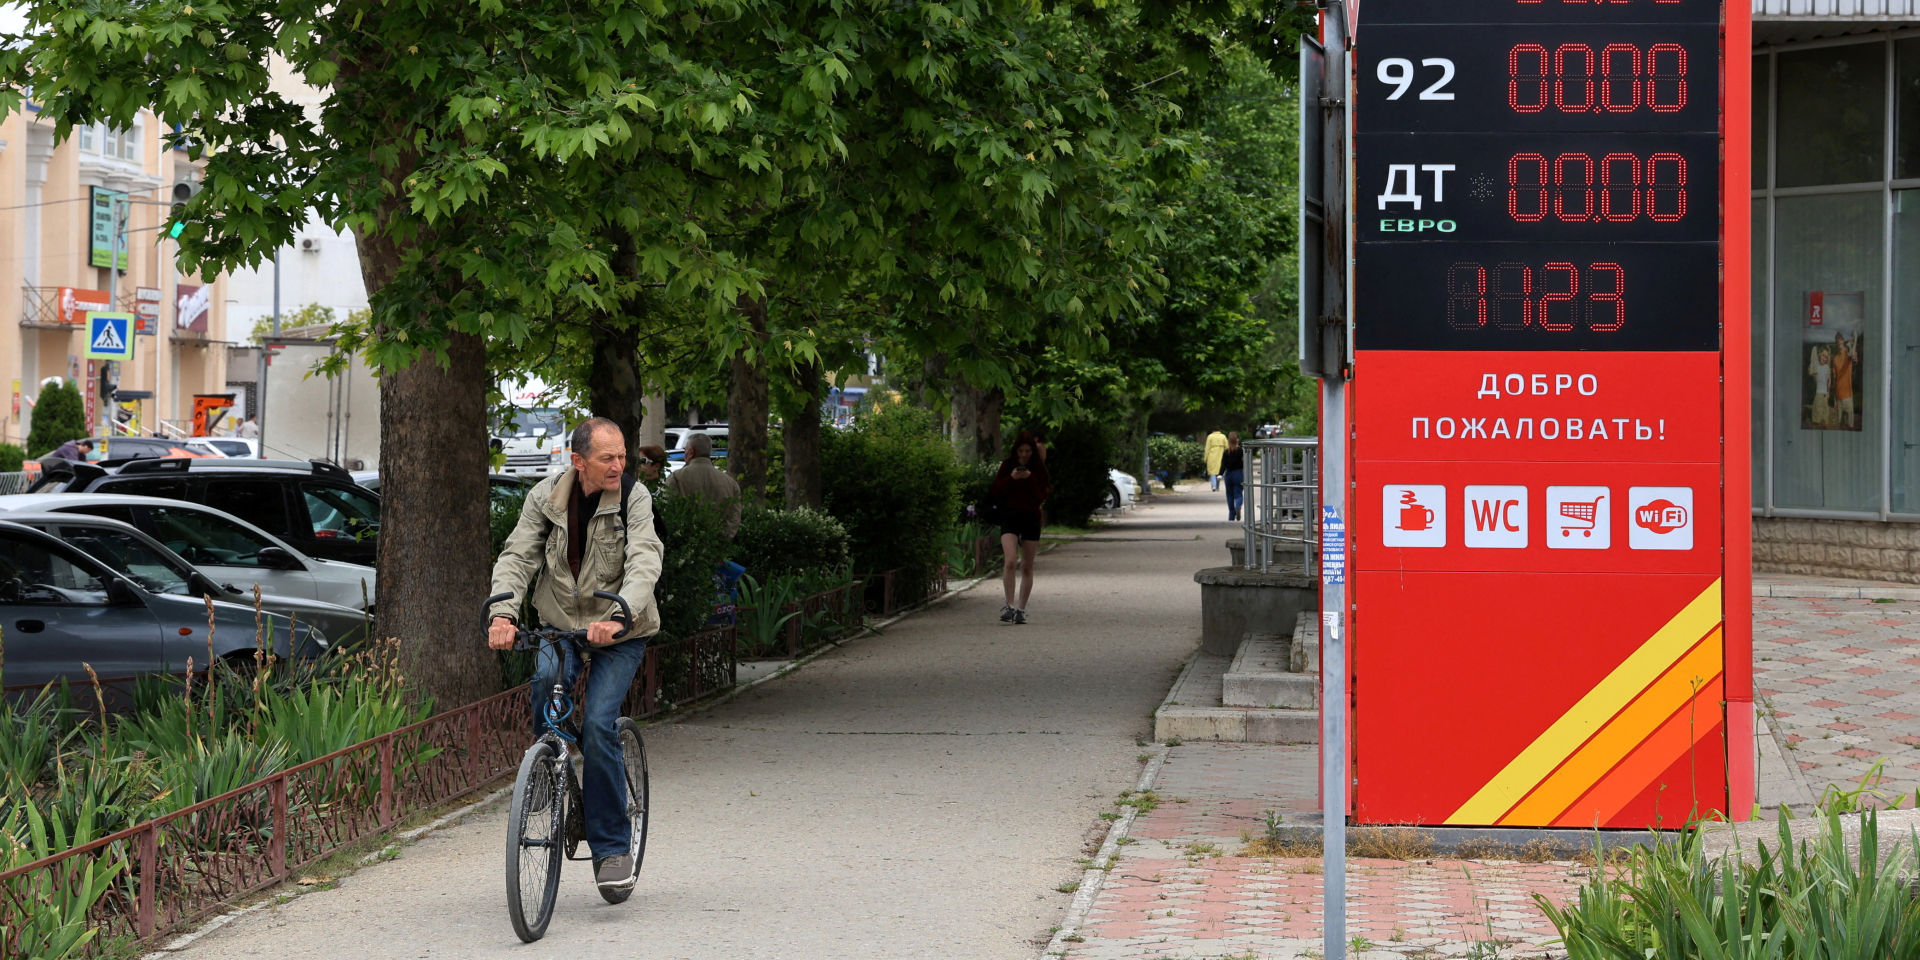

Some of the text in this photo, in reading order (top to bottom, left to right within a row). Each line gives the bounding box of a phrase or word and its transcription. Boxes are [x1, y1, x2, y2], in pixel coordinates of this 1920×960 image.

[1376, 57, 1455, 101] 92
[1377, 164, 1456, 211] ДТ
[1379, 218, 1457, 233] ЕВРО
[1477, 373, 1598, 400] ДОБРО
[1412, 416, 1665, 441] ПОЖАЛОВАТЬ!
[1471, 499, 1520, 532] WC
